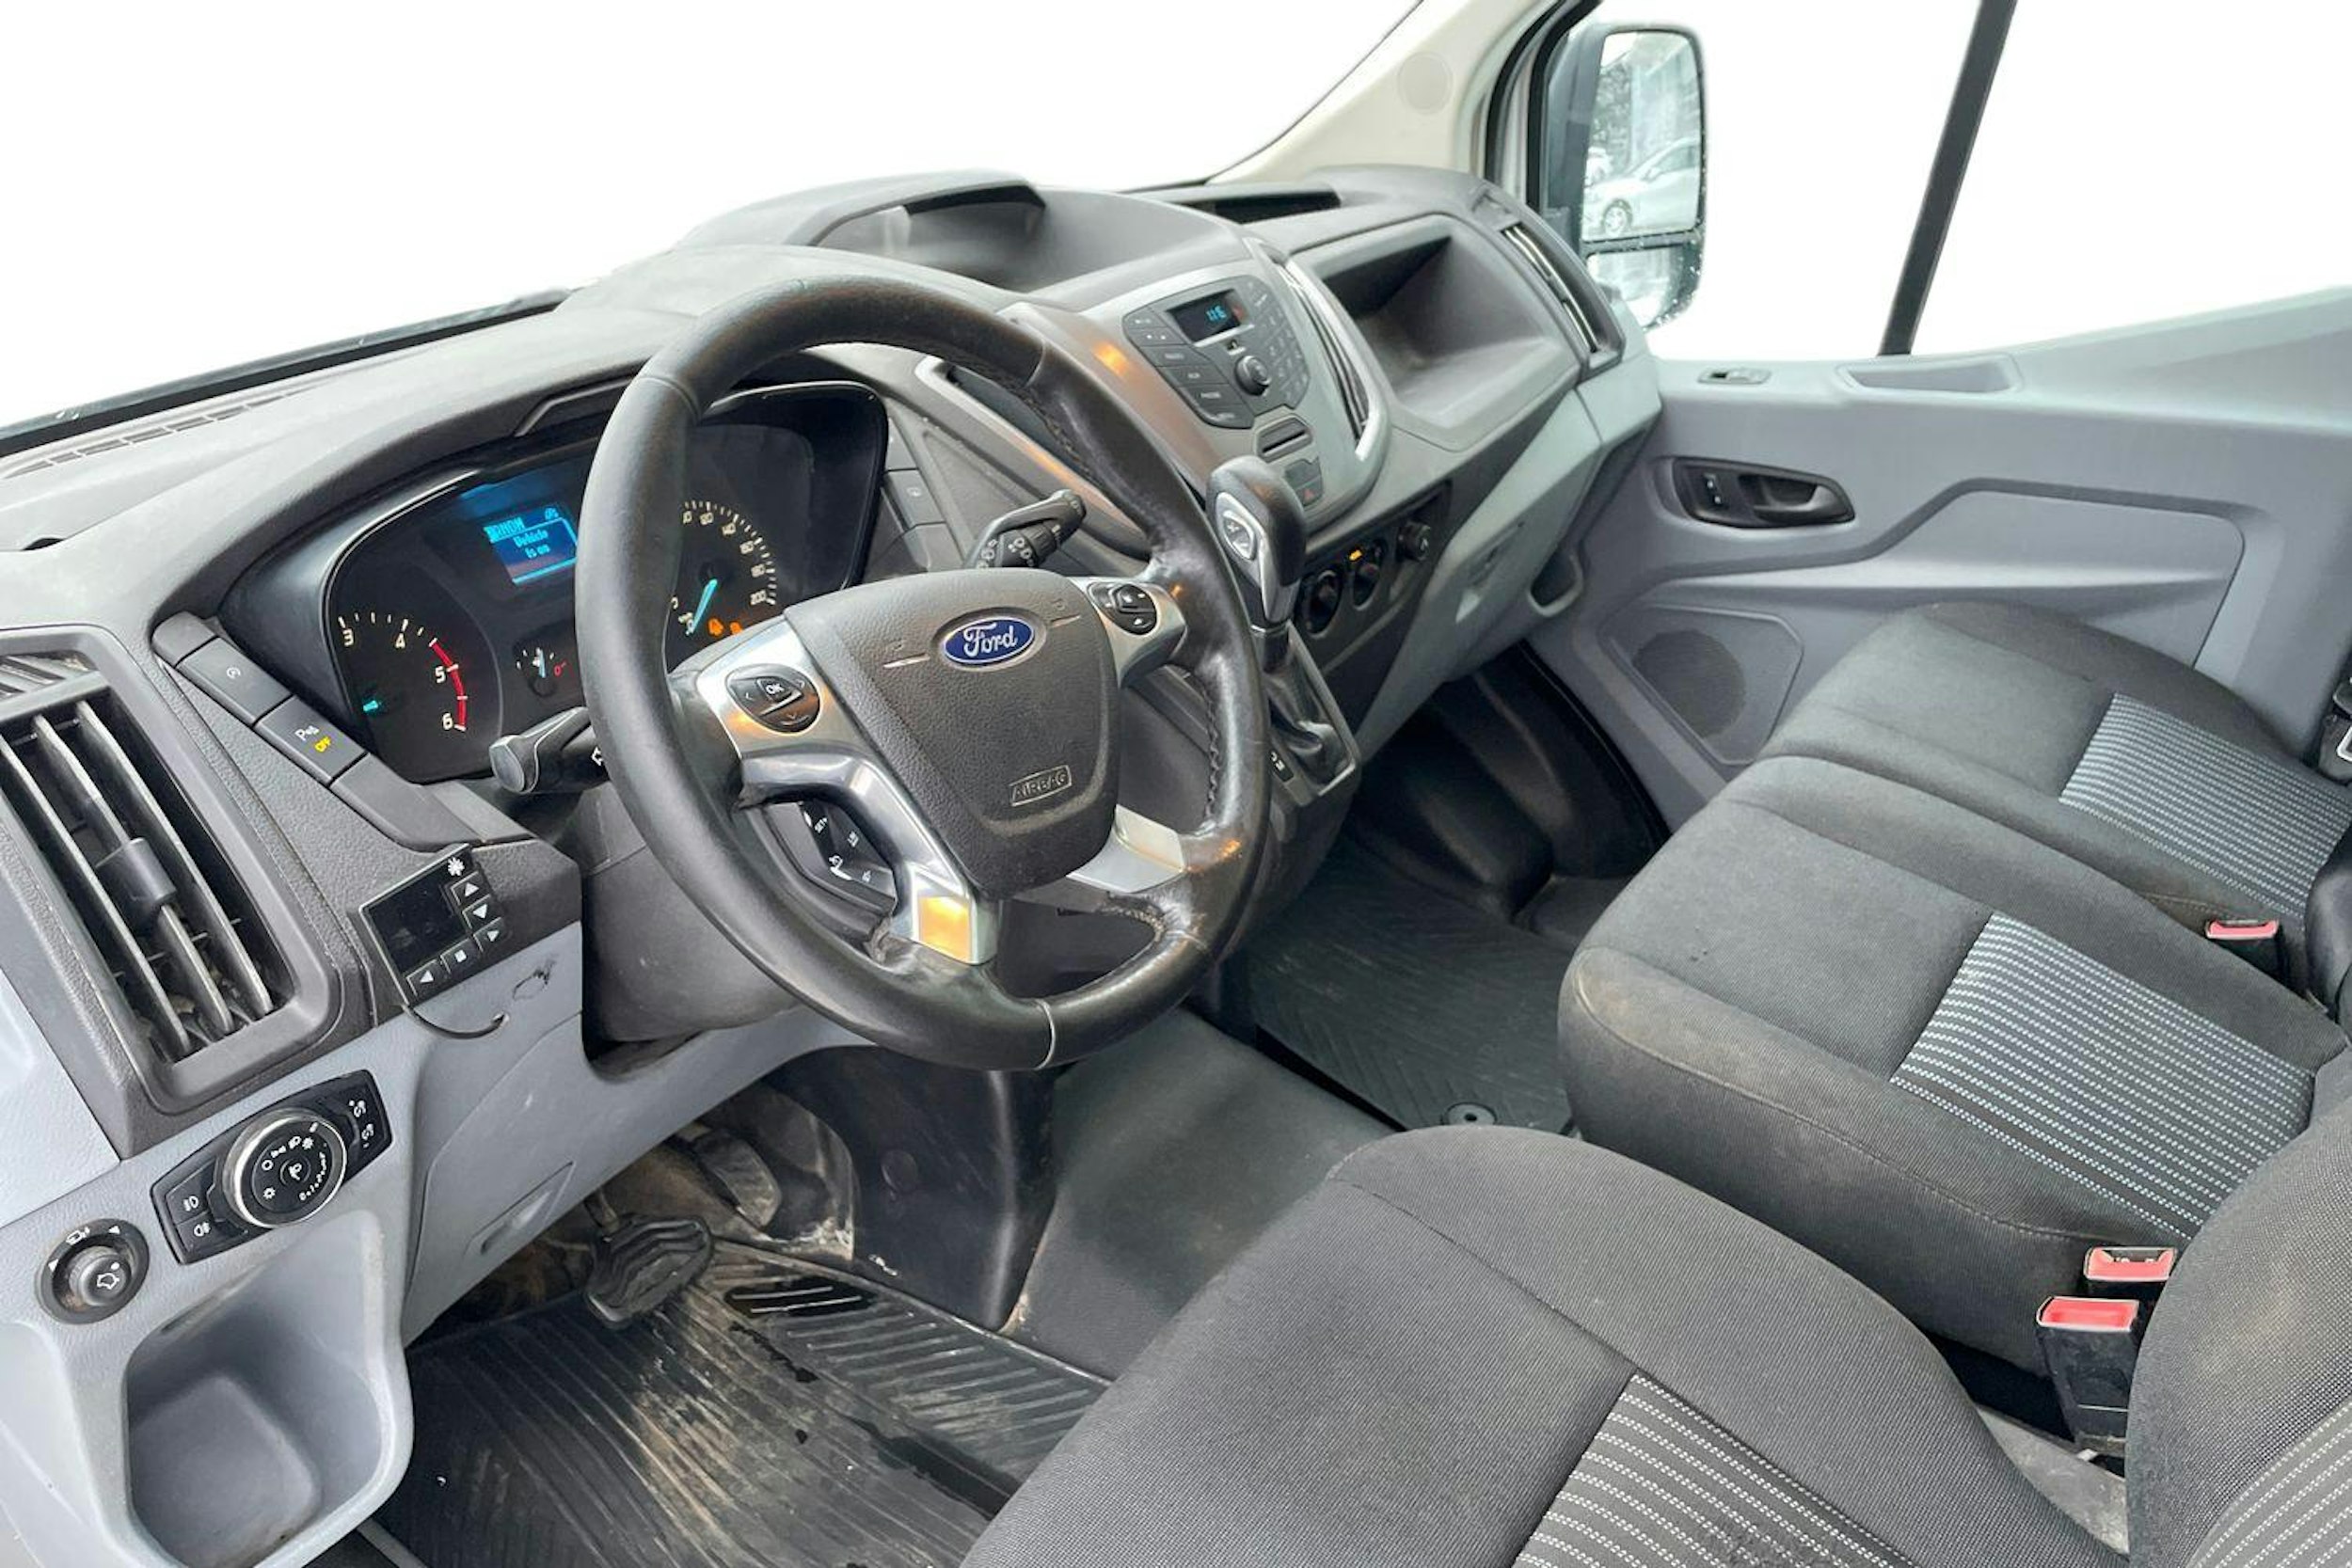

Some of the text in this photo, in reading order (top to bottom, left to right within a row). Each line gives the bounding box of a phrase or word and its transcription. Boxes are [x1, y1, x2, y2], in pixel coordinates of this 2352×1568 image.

[342, 628, 355, 647] 3
[394, 633, 406, 649] 4
[962, 622, 1018, 657] Ford
[435, 666, 447, 684] 5
[765, 683, 786, 695] OK
[441, 712, 453, 731] 6
[1012, 770, 1068, 801] AIRBAG
